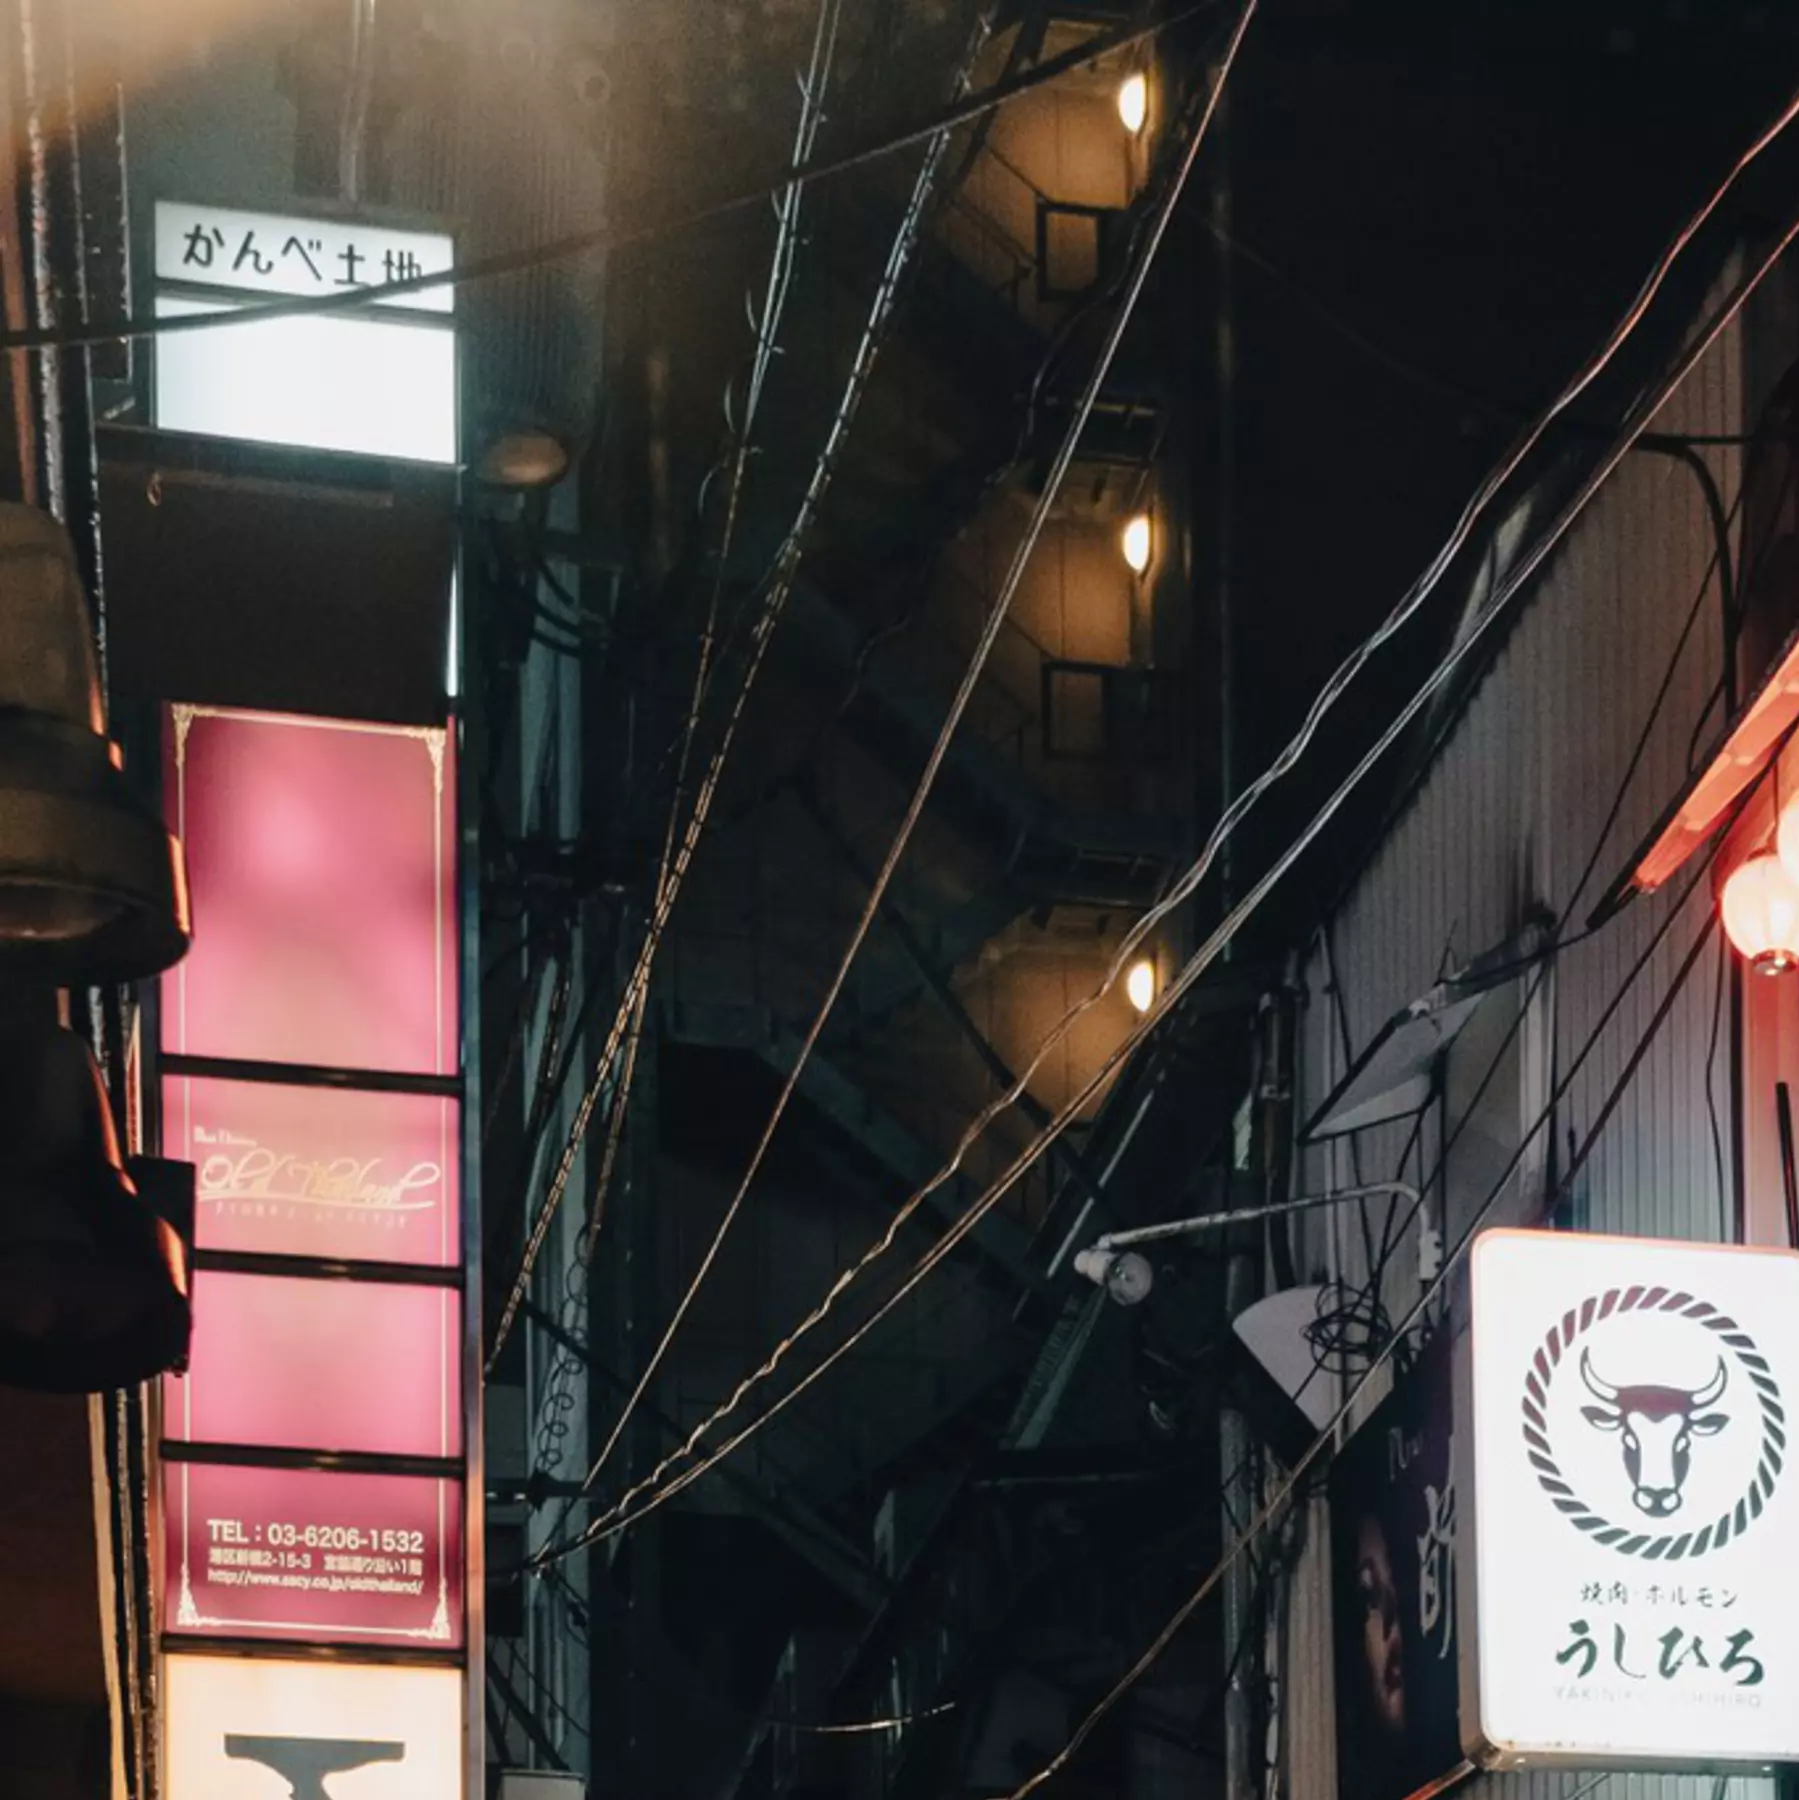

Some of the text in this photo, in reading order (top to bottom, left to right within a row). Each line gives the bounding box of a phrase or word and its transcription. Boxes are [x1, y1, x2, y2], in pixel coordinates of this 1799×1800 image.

[184, 224, 421, 287] かんべ土地
[267, 1522, 424, 1553] 03-6206-1532
[1555, 1618, 1765, 1687] うしひろ
